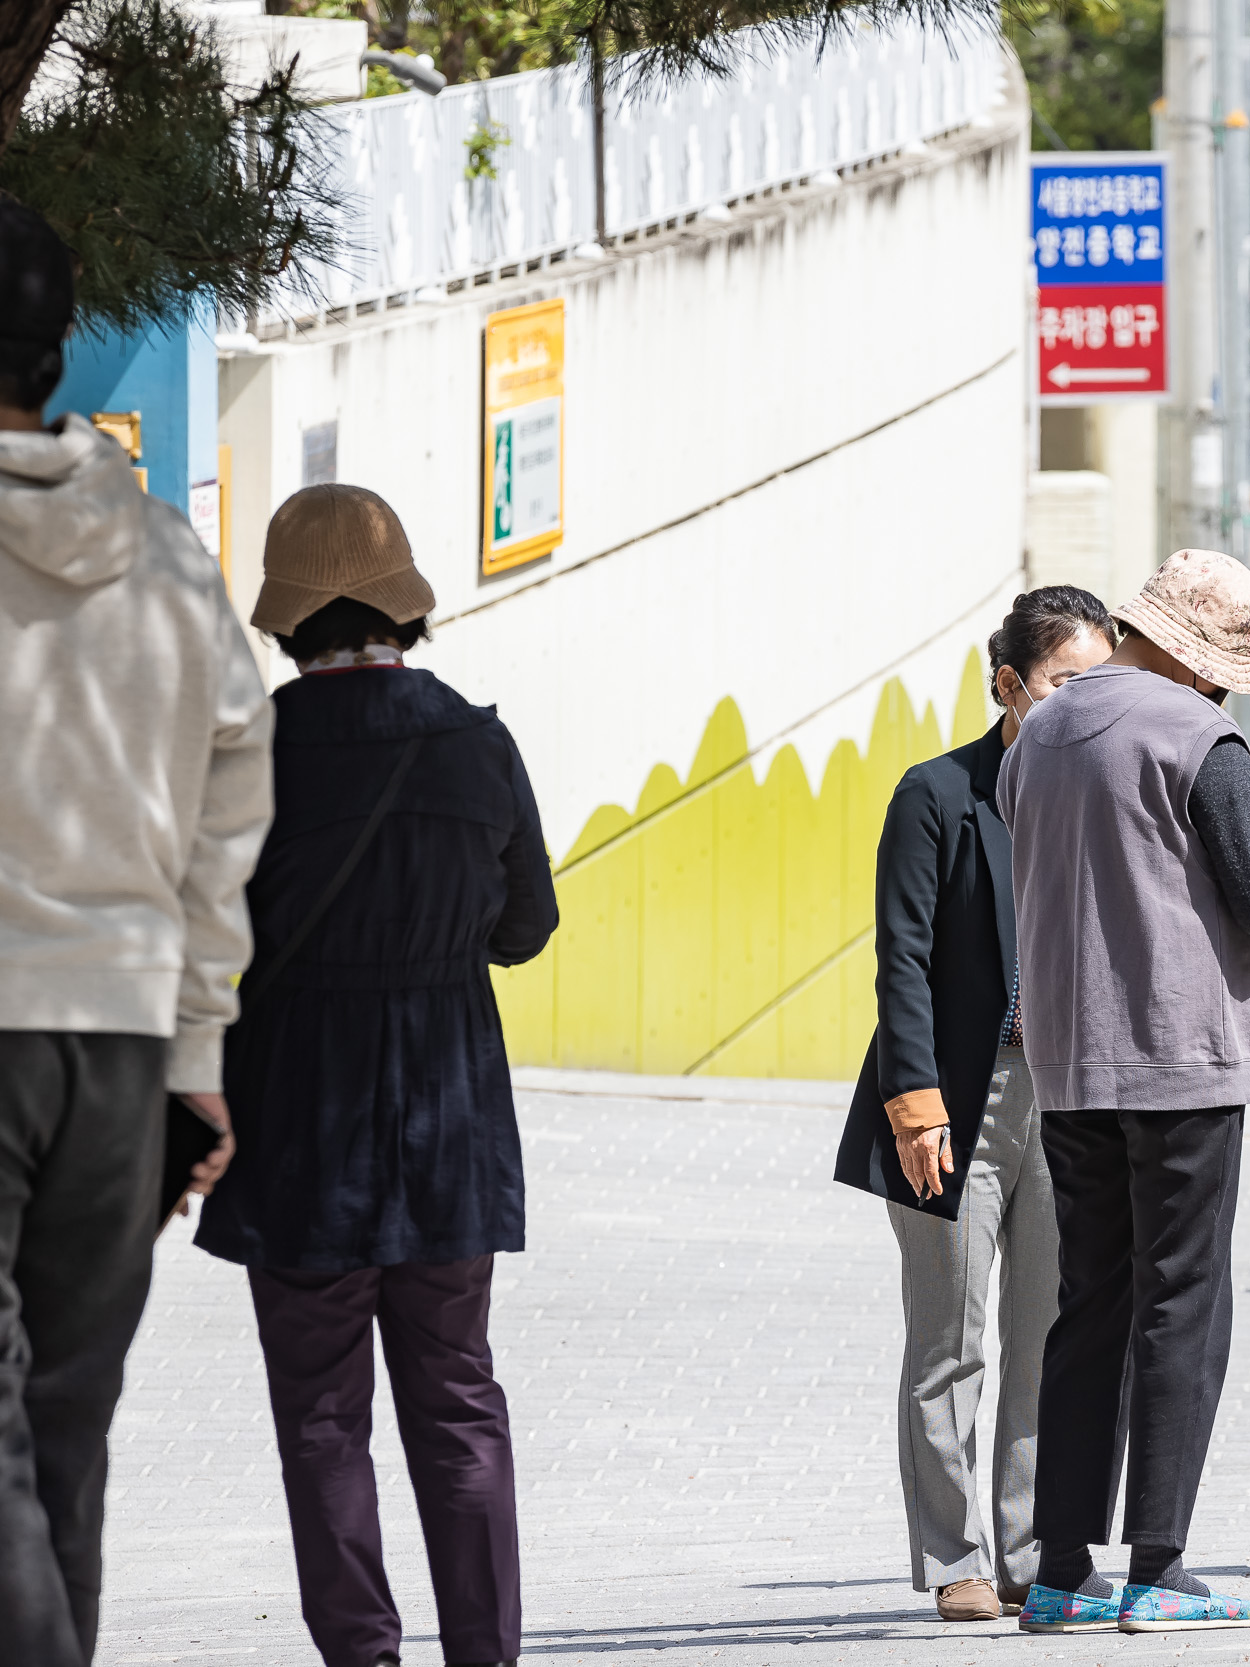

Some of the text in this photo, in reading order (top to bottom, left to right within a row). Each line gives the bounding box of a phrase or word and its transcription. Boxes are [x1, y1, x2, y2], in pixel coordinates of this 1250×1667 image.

[1036, 225, 1161, 267] 양진중학교
[1040, 304, 1159, 349] 주차장 입구
